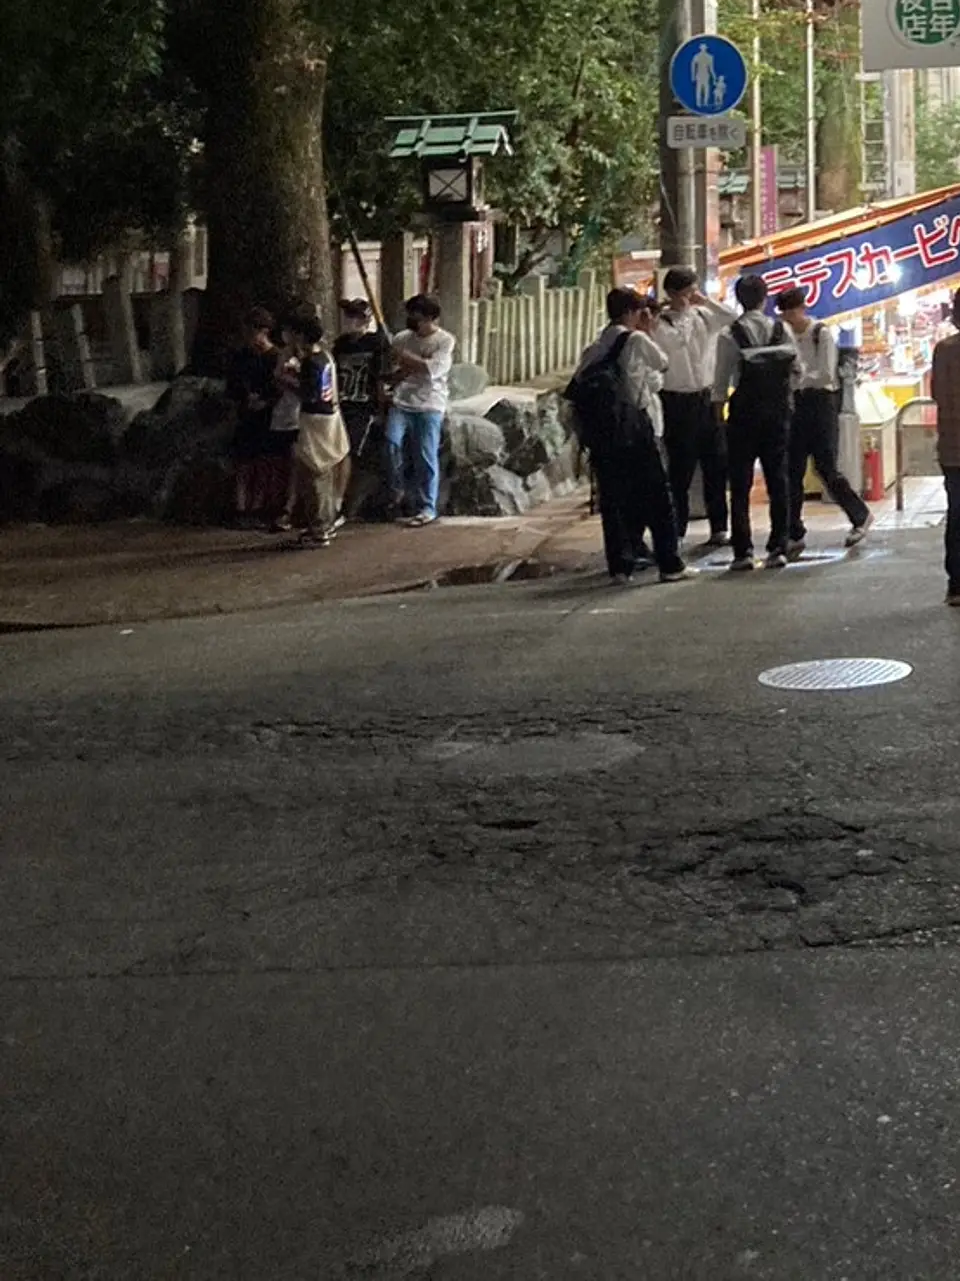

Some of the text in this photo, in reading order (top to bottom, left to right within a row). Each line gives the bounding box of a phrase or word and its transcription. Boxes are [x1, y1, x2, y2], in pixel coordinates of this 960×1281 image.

[674, 123, 740, 142] 自転車を除く
